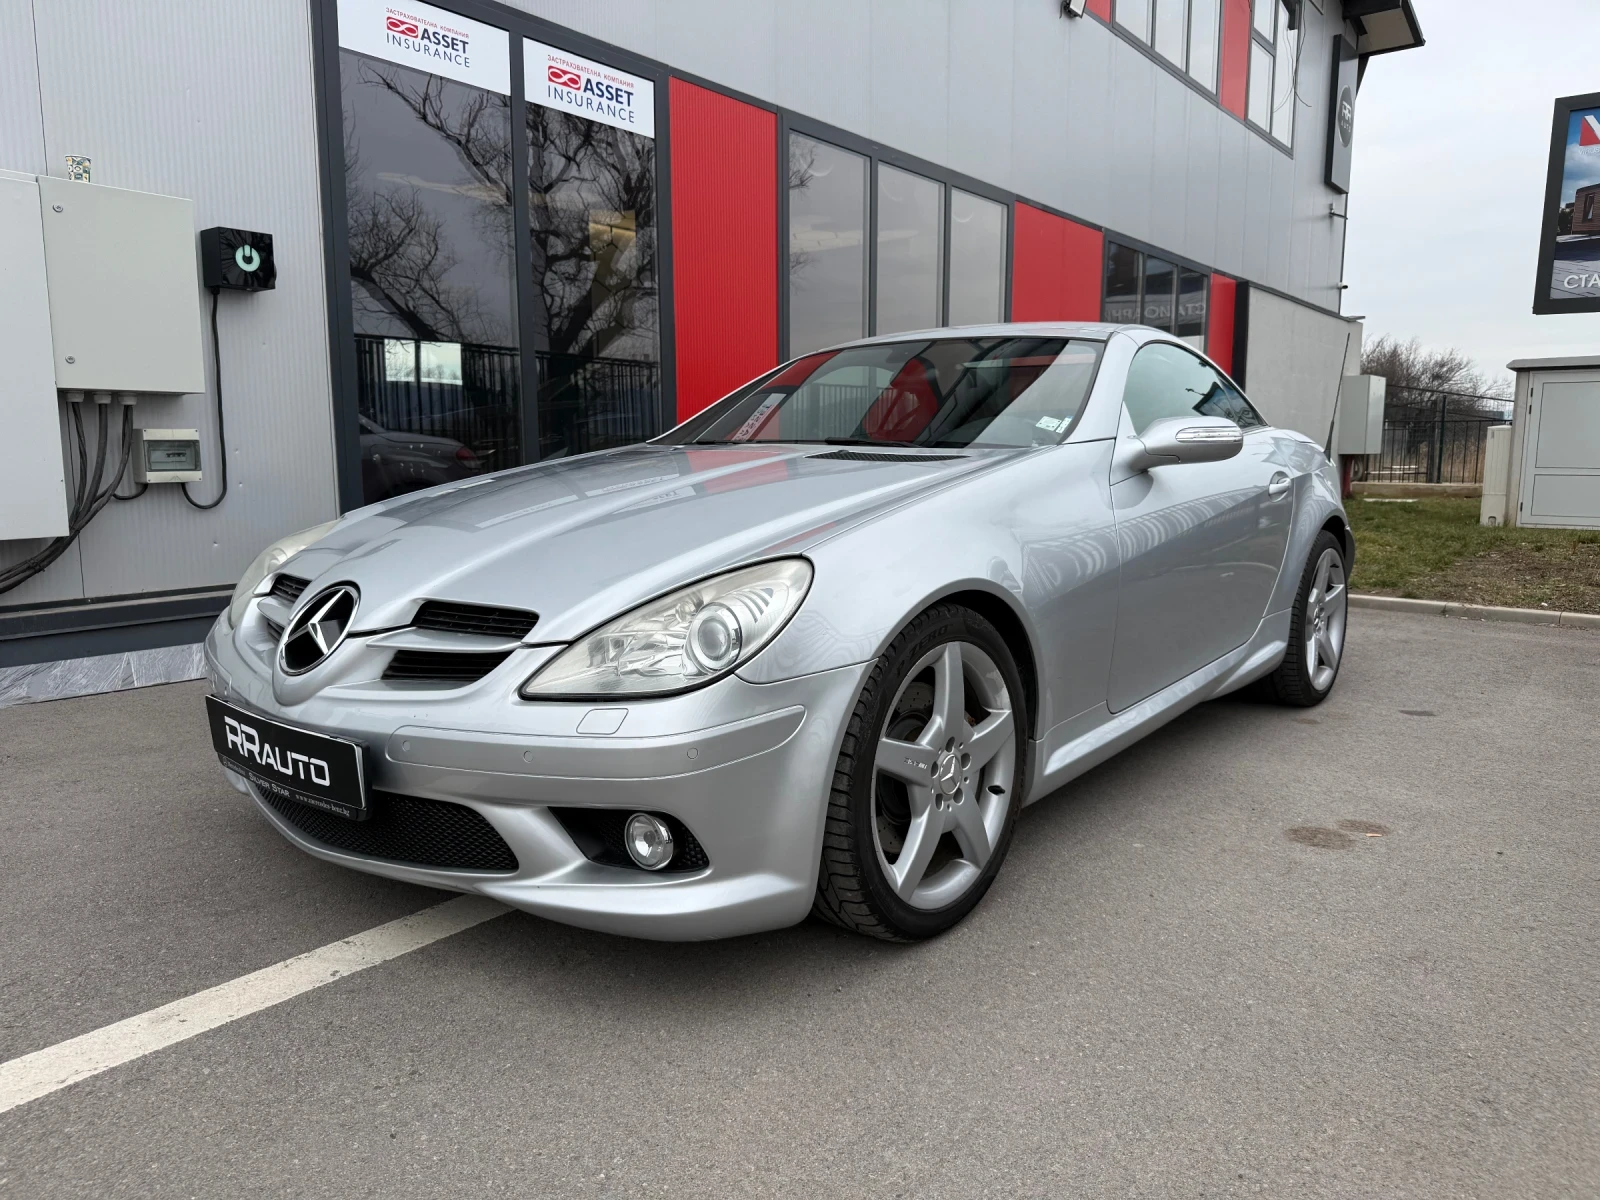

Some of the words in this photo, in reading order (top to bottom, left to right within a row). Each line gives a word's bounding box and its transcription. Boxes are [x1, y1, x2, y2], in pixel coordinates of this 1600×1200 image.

[386, 7, 438, 28] ЗАСТРАХОВАТЕЛНА
[440, 26, 469, 38] КОМПАНИЯ
[386, 32, 470, 68] INSURANCE
[421, 28, 469, 54] ASSET
[548, 54, 601, 78] ЗАСТРАХОВАТЕЛНА
[604, 74, 634, 88] КОМПАНИЯ
[548, 85, 634, 124] INSURANCE
[583, 78, 634, 107] ASSET
